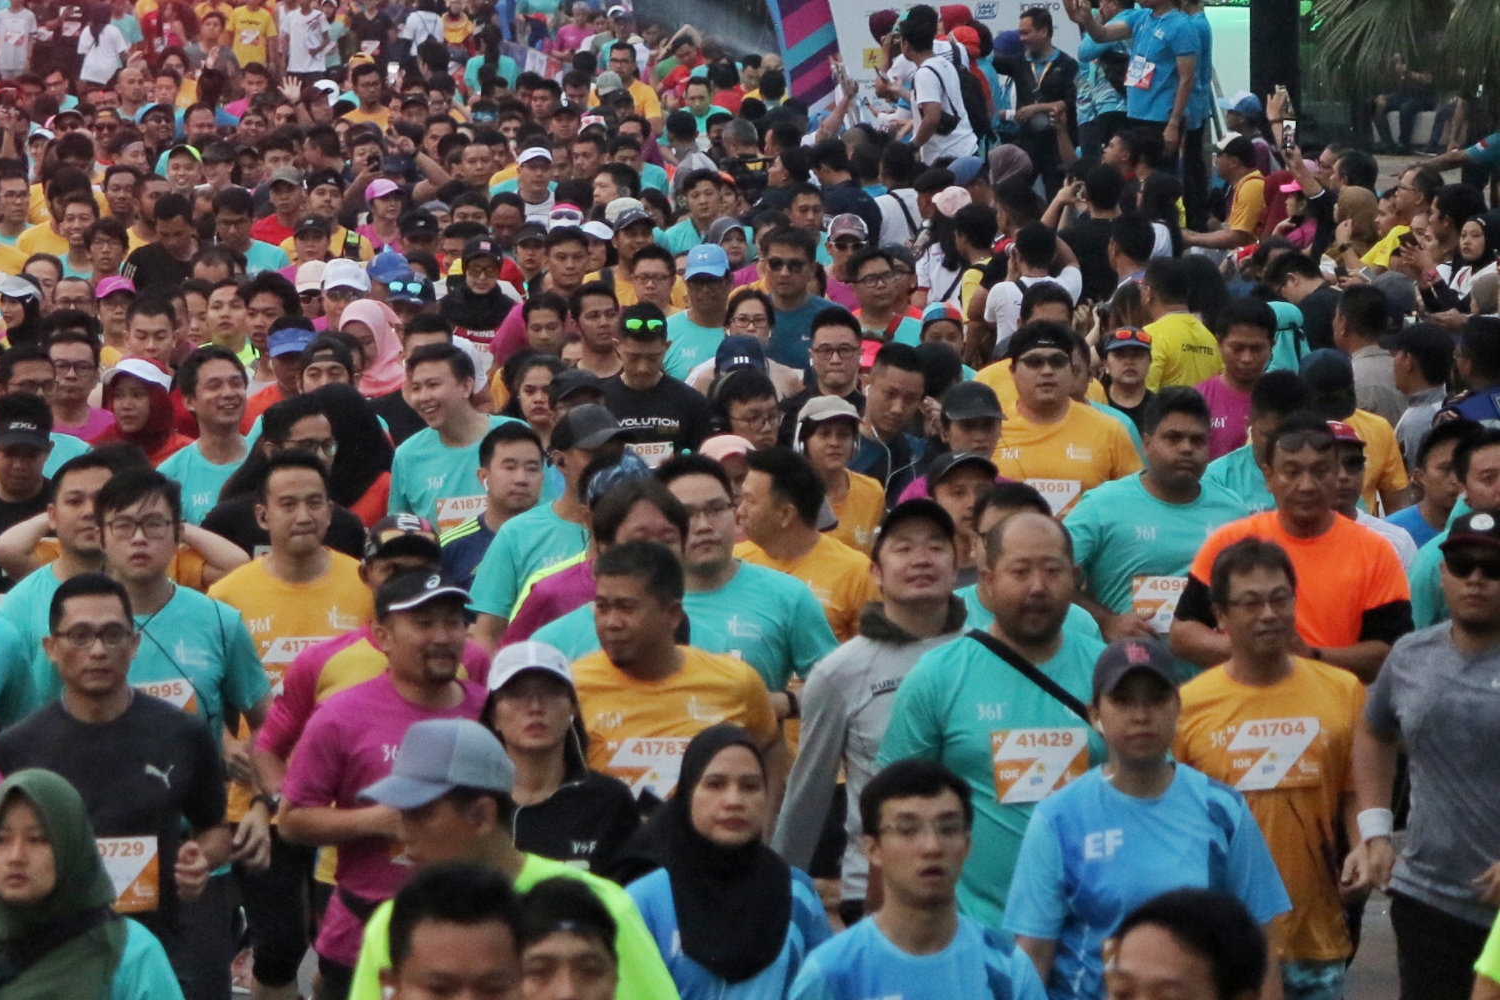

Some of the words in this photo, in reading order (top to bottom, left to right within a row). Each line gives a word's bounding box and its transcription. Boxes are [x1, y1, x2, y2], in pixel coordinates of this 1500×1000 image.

[9, 421, 37, 430] 2XU
[635, 446, 666, 456] 0857
[145, 682, 184, 698] 995
[1247, 721, 1307, 738] 41704
[1015, 731, 1074, 748] 41429
[100, 841, 146, 858] 0729
[1084, 829, 1123, 859] EF
